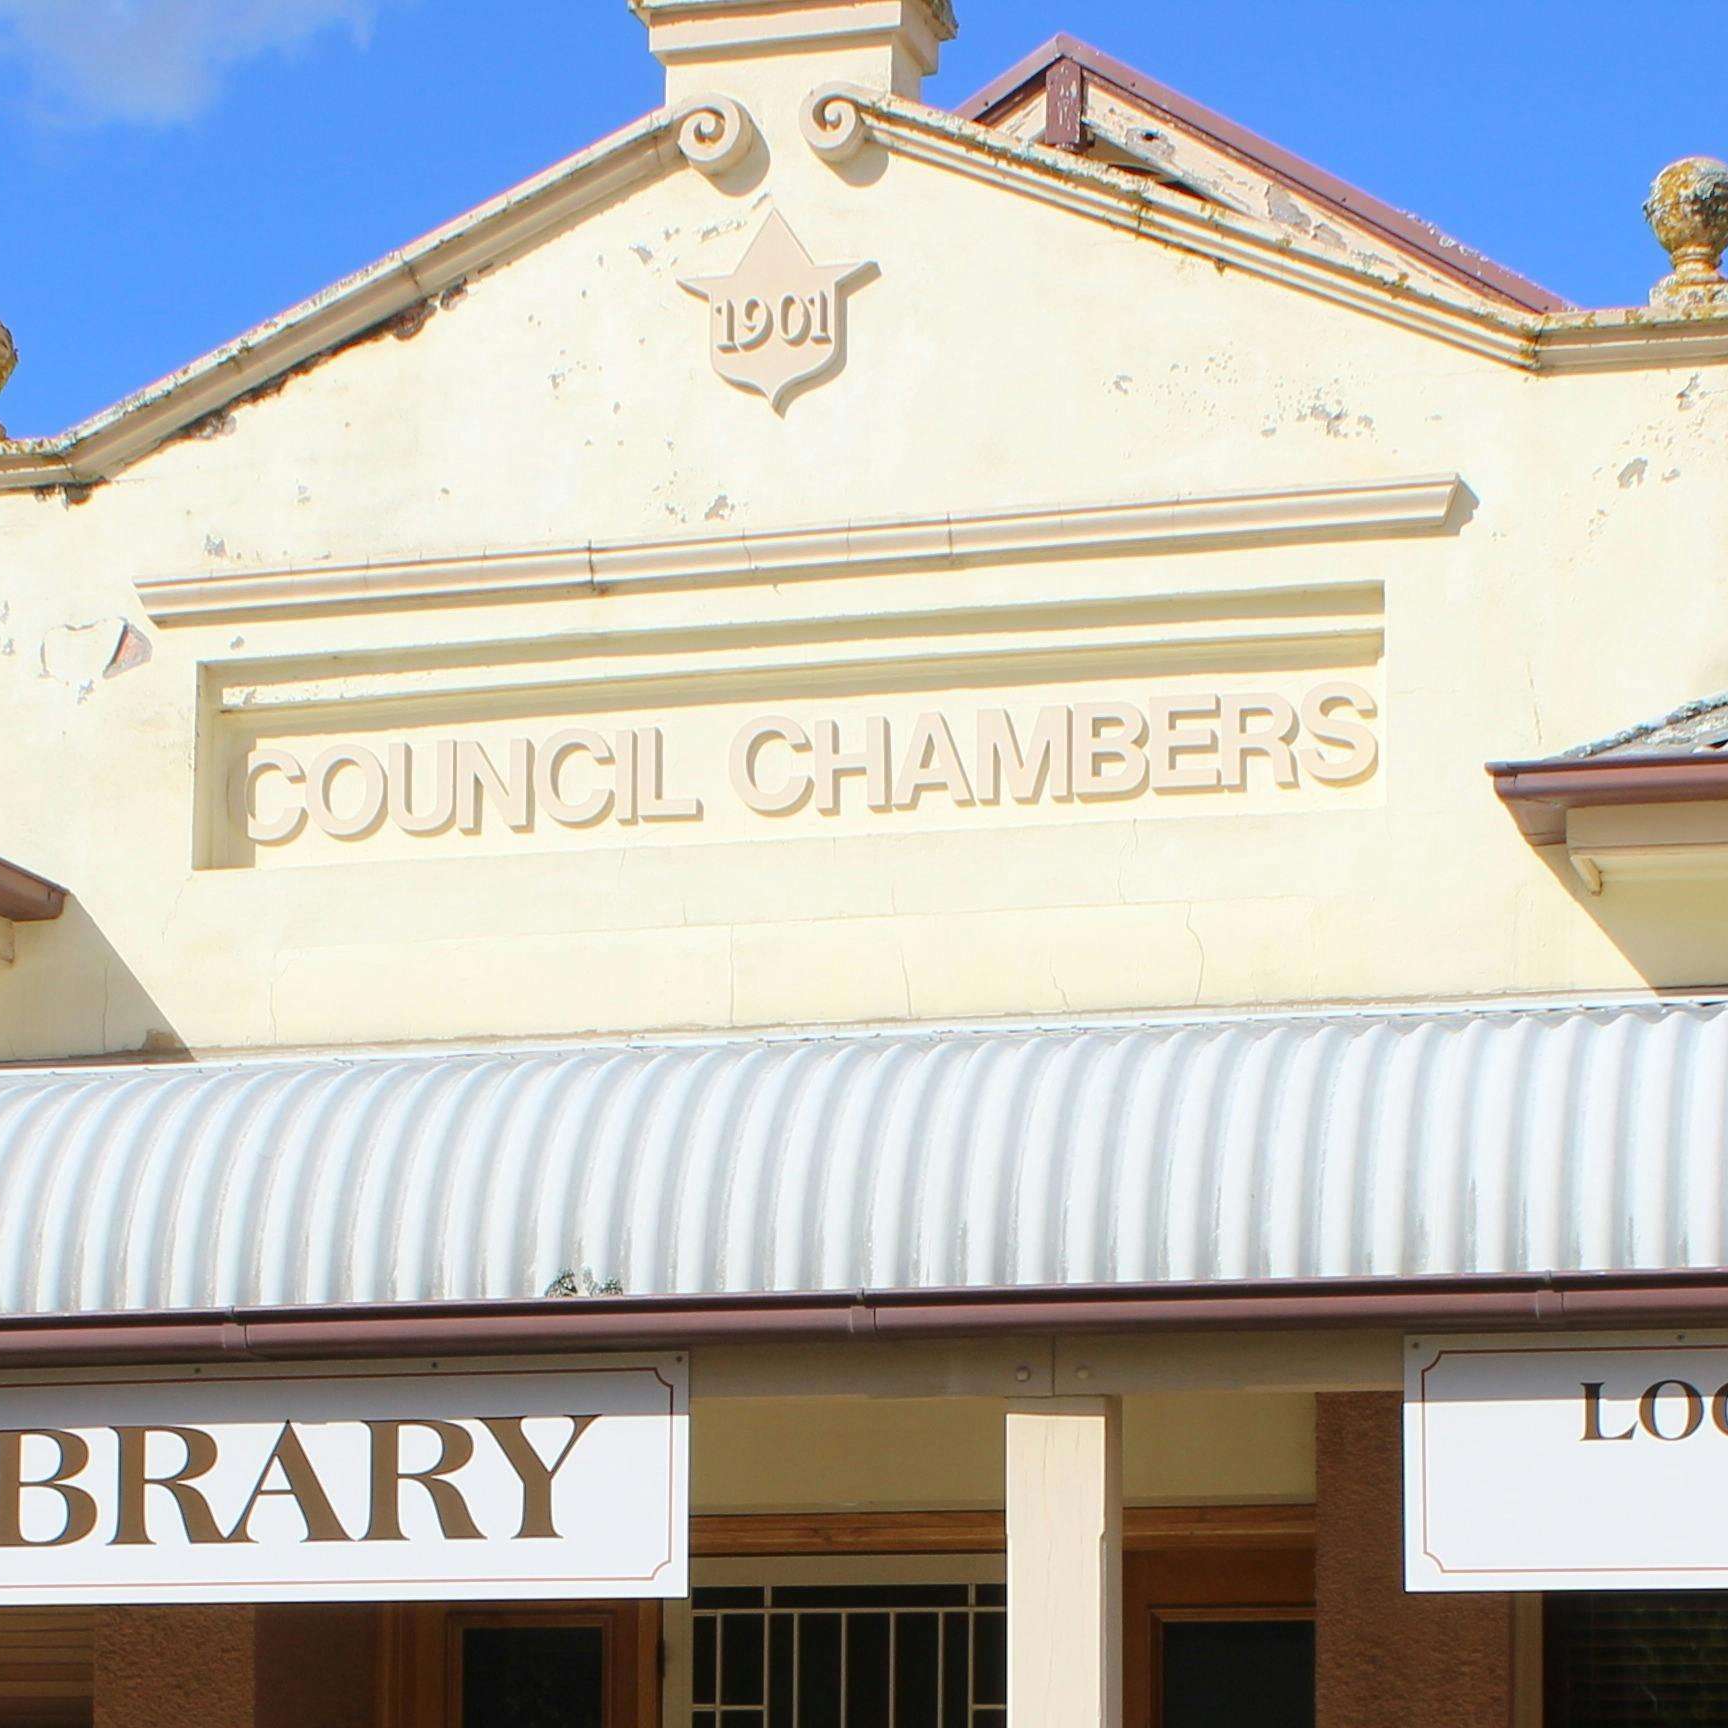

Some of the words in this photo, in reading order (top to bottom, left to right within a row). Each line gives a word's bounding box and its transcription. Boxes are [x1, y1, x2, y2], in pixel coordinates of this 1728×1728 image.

[715, 290, 832, 354] 1901
[234, 722, 702, 846] COUNCIL
[729, 681, 1381, 816] CHAMBERS
